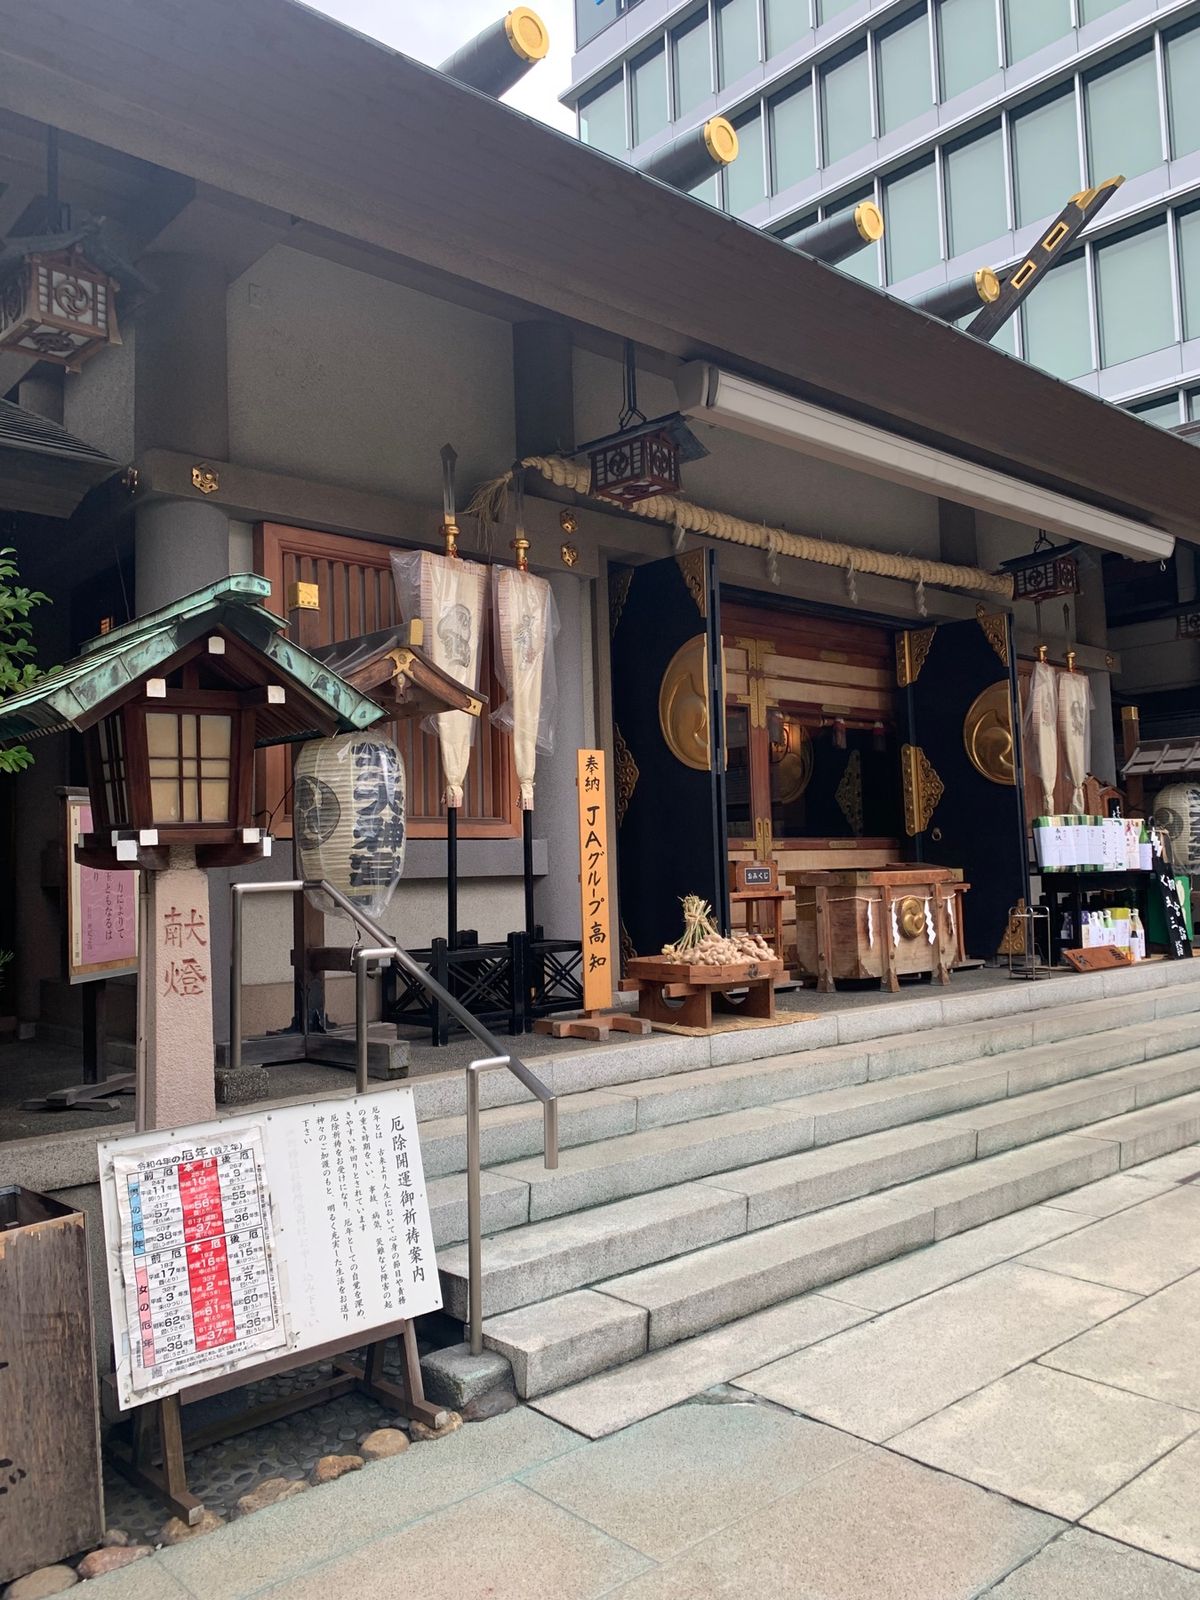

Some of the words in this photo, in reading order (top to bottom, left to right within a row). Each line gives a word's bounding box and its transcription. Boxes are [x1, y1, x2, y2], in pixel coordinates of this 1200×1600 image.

[584, 755, 600, 792] 奉納
[747, 872, 769, 880] おみくじ
[164, 906, 207, 997] 献燈
[301, 1118, 312, 1144] 下さい
[221, 1150, 249, 1164] 後厄
[183, 1157, 212, 1172] 本厄
[143, 1165, 173, 1181] 前厄
[153, 1201, 167, 1209] 41才
[391, 1115, 425, 1283] 厄除開運御祈祷案内
[234, 1206, 247, 1214] 62才
[155, 1224, 170, 1232] 60才
[229, 1229, 258, 1244] 後厄
[191, 1238, 221, 1253] 本厄
[238, 1241, 251, 1249] 20才
[150, 1247, 181, 1264] 前厄
[159, 1260, 173, 1269] 18才
[161, 1284, 176, 1293] 32才
[163, 1308, 178, 1317] 36才
[166, 1333, 180, 1342] 60才
